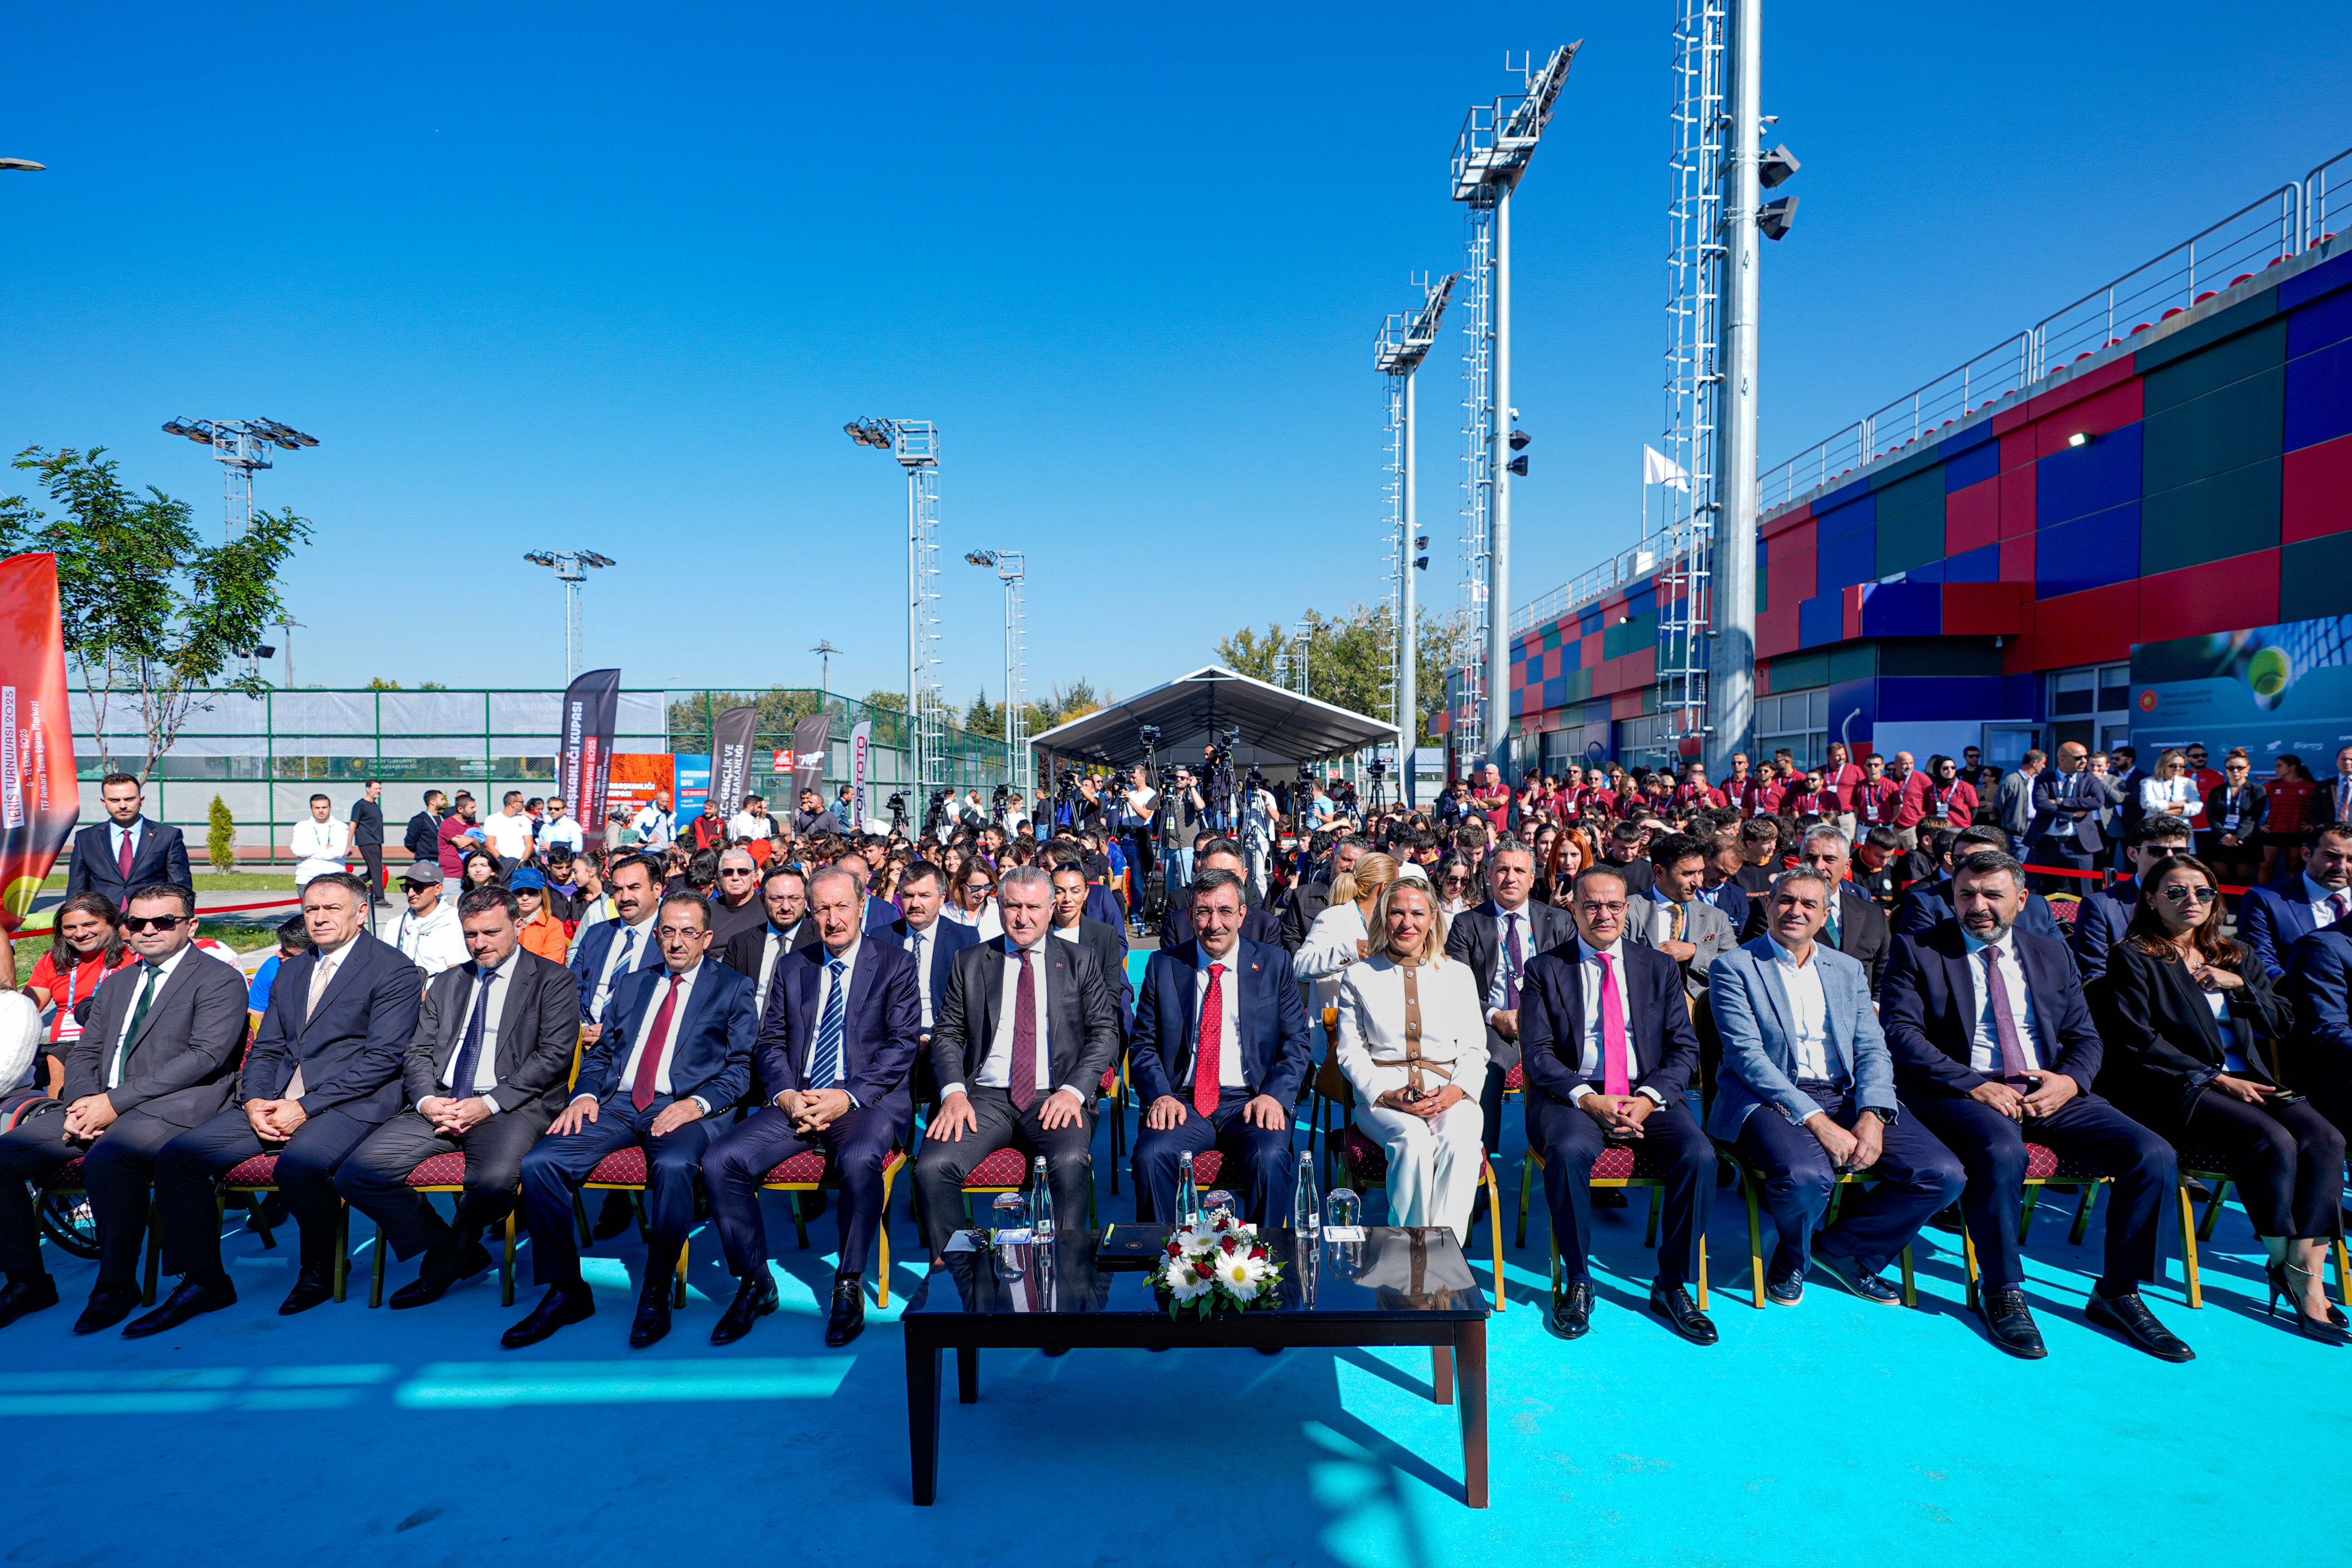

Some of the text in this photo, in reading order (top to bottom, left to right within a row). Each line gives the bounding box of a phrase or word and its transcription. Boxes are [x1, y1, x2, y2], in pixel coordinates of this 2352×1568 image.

[20, 728, 29, 749] 2025
[569, 701, 583, 744] KUPASI
[4, 691, 22, 824] TENİS TURNUVASI 2025
[22, 750, 32, 767] Ekim
[24, 768, 33, 777] 12
[29, 701, 50, 811] TTF Ankara Tenis Eğitim Merkezi
[732, 744, 745, 794] BAKANLIĞI
[857, 736, 865, 785] TOTO
[581, 740, 597, 831] TENİS TURNUVASI 2025
[719, 744, 734, 818] T.C. GENÇLİK VE
